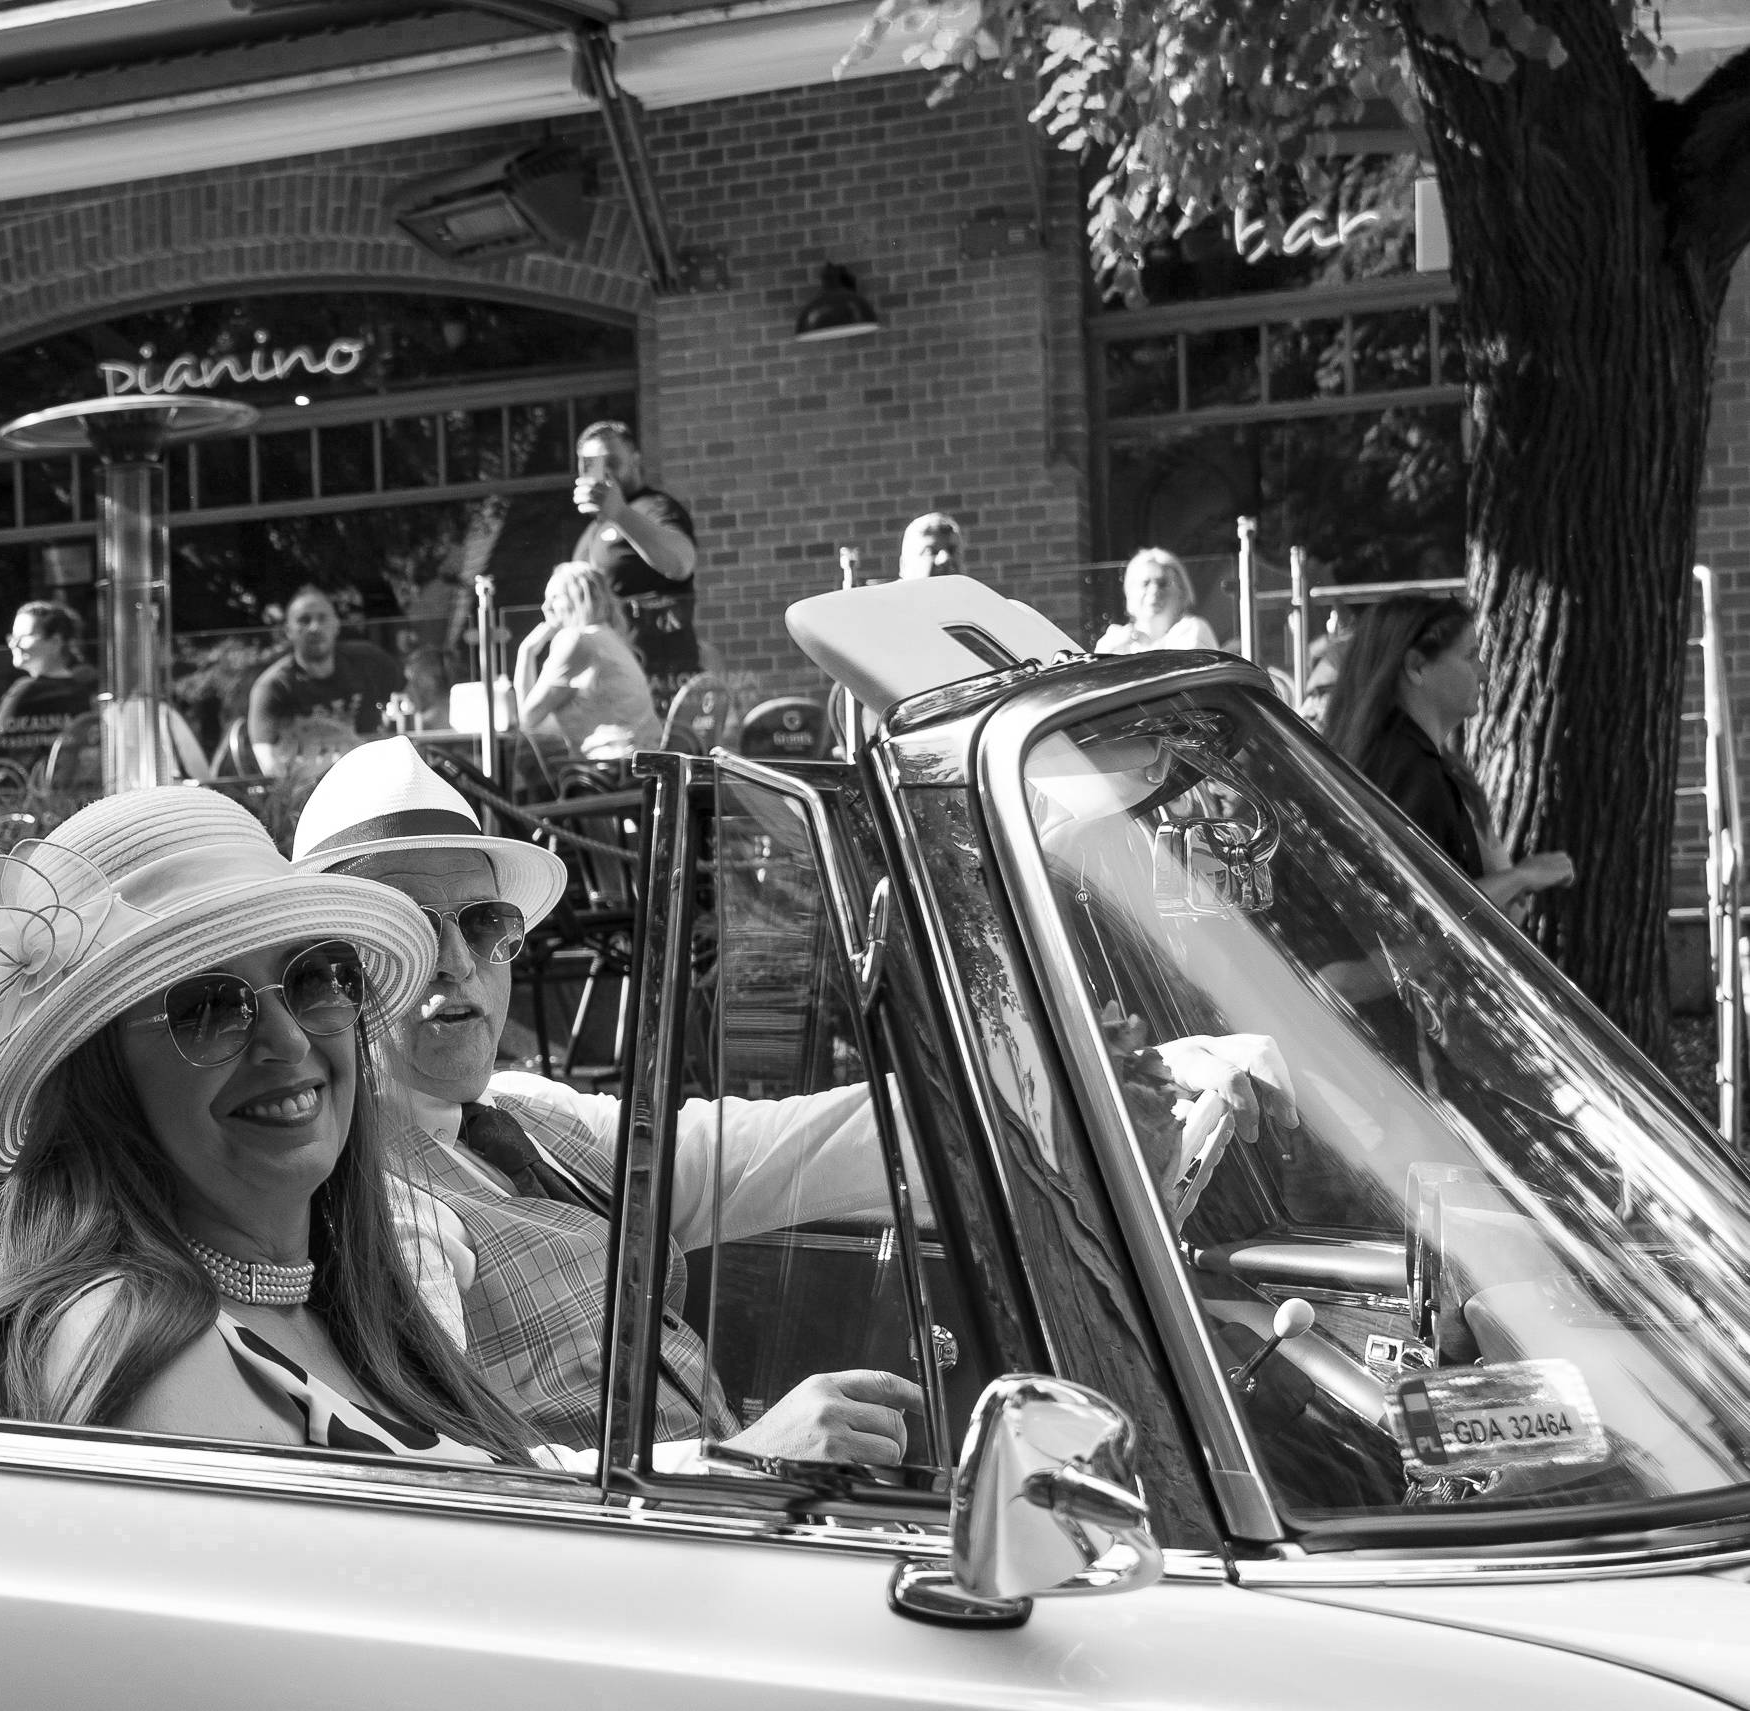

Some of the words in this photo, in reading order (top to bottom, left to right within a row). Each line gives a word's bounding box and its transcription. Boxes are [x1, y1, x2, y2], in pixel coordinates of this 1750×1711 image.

[1452, 1416, 1505, 1445] GDA
[1508, 1411, 1572, 1440] 32464
[1415, 1435, 1442, 1454] PL
